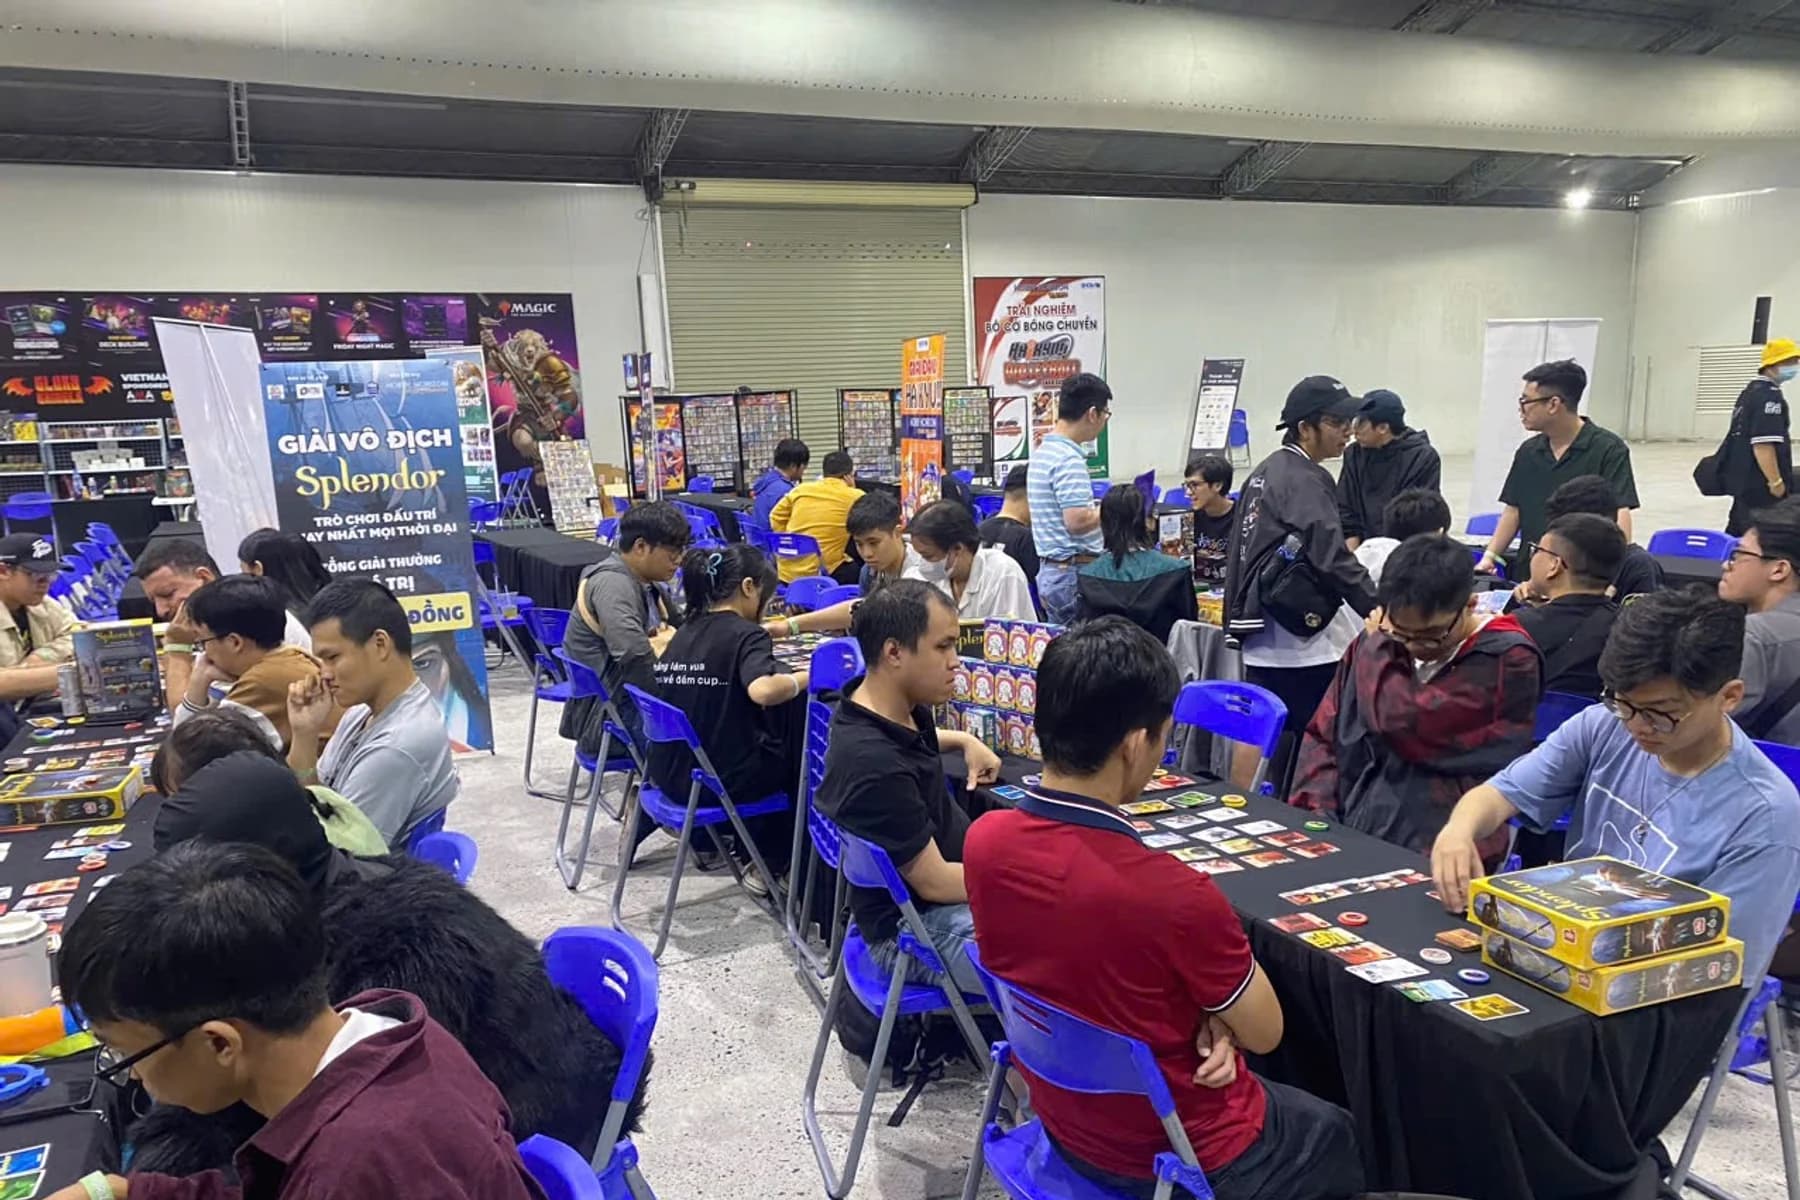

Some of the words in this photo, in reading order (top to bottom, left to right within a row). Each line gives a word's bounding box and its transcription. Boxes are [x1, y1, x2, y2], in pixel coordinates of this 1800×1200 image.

[510, 303, 556, 314] MAGIC
[278, 428, 336, 454] GIẢI
[339, 427, 380, 452] VÔ
[386, 429, 452, 454] ĐỊCH
[295, 456, 446, 510] Splendor
[313, 513, 342, 527] TRÒ
[383, 509, 413, 523] ĐẤU
[415, 508, 436, 521] TRÍ
[301, 531, 324, 542] AY
[327, 526, 365, 541] NHẤT
[369, 527, 396, 540] MỌI
[432, 522, 457, 536] ĐẠI
[385, 575, 416, 592] TRỊ
[408, 600, 465, 625] ĐỒNG
